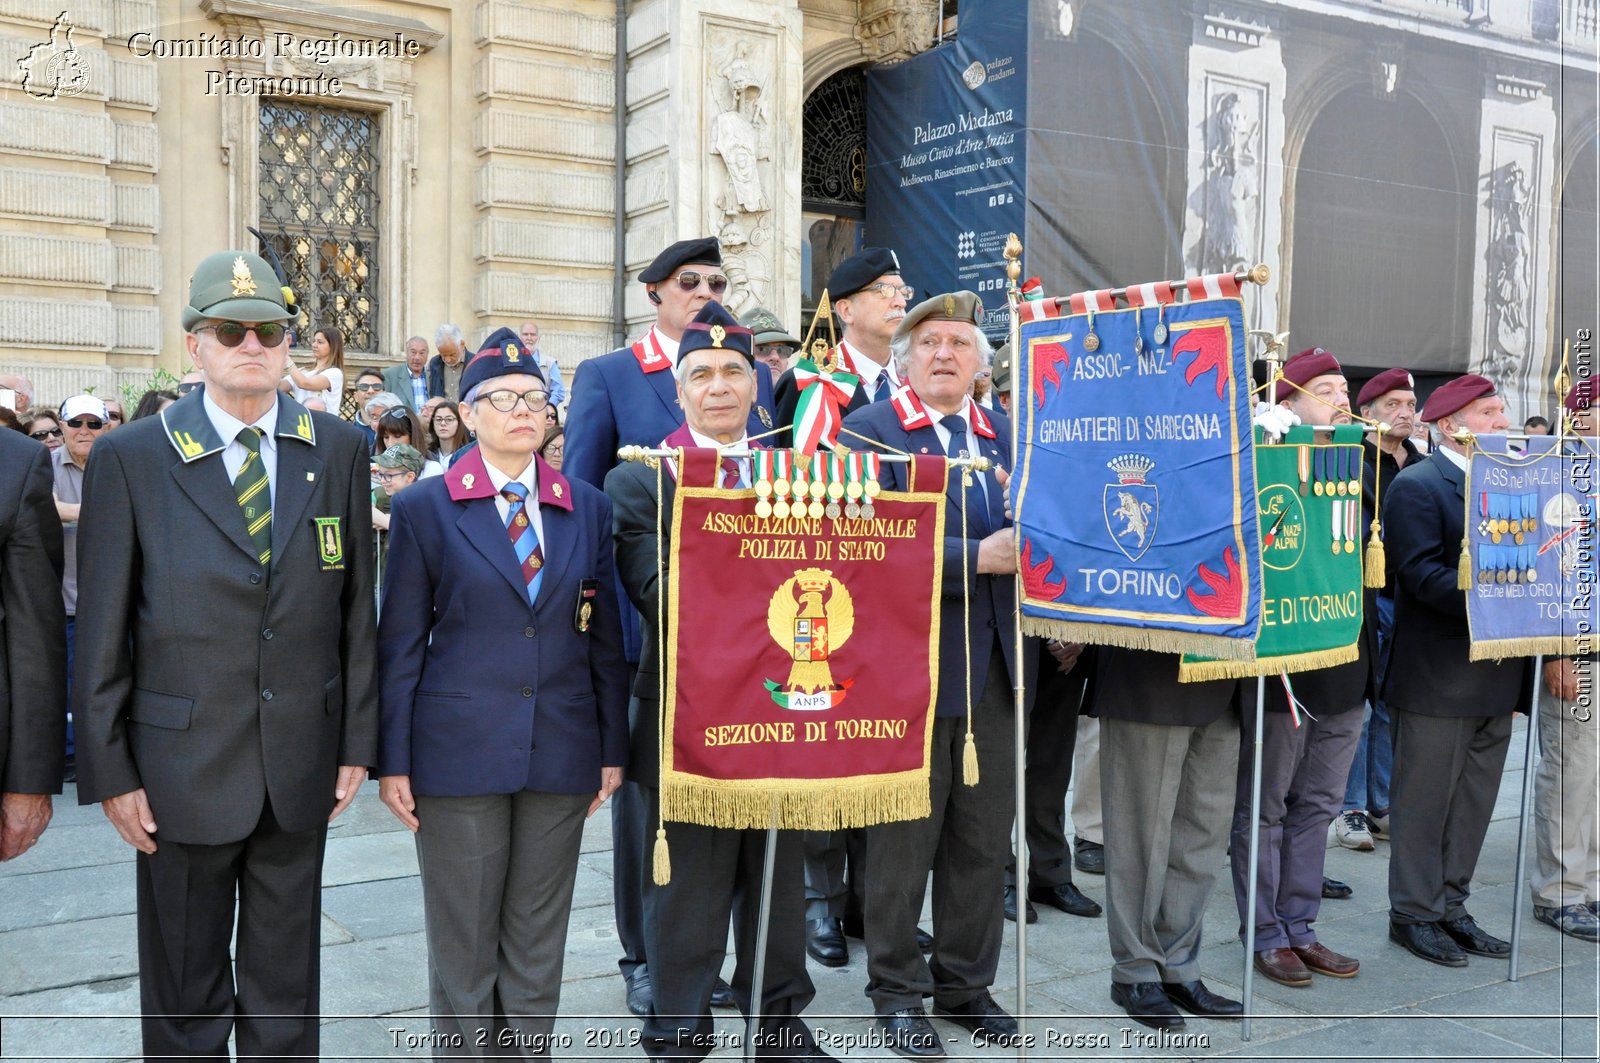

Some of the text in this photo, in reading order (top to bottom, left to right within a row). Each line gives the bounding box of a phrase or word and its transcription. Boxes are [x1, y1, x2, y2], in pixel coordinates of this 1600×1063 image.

[986, 56, 1013, 73] palazzo
[987, 67, 1015, 83] madama
[913, 107, 1014, 146] Palazzo Madama
[900, 132, 1014, 169] Museo Civico d'Arte Antica
[900, 154, 1014, 188] Medioevo, Rinascimento e Barocco
[988, 311, 1010, 323] Pinto
[1040, 413, 1222, 444] GRANATIERI DI SARDEGNA
[702, 511, 917, 539] ASSOCIAZIONE NAZIONALE
[738, 538, 886, 561] POLIZIA DI STATO
[1274, 537, 1299, 550] ALPINI
[1078, 568, 1182, 600] TORINO
[1529, 583, 1553, 598] ORO
[1281, 598, 1298, 625] DI
[1300, 590, 1357, 623] TORINO
[794, 696, 827, 707] ANPS
[704, 718, 909, 747] SEZIONE DI TORINO
